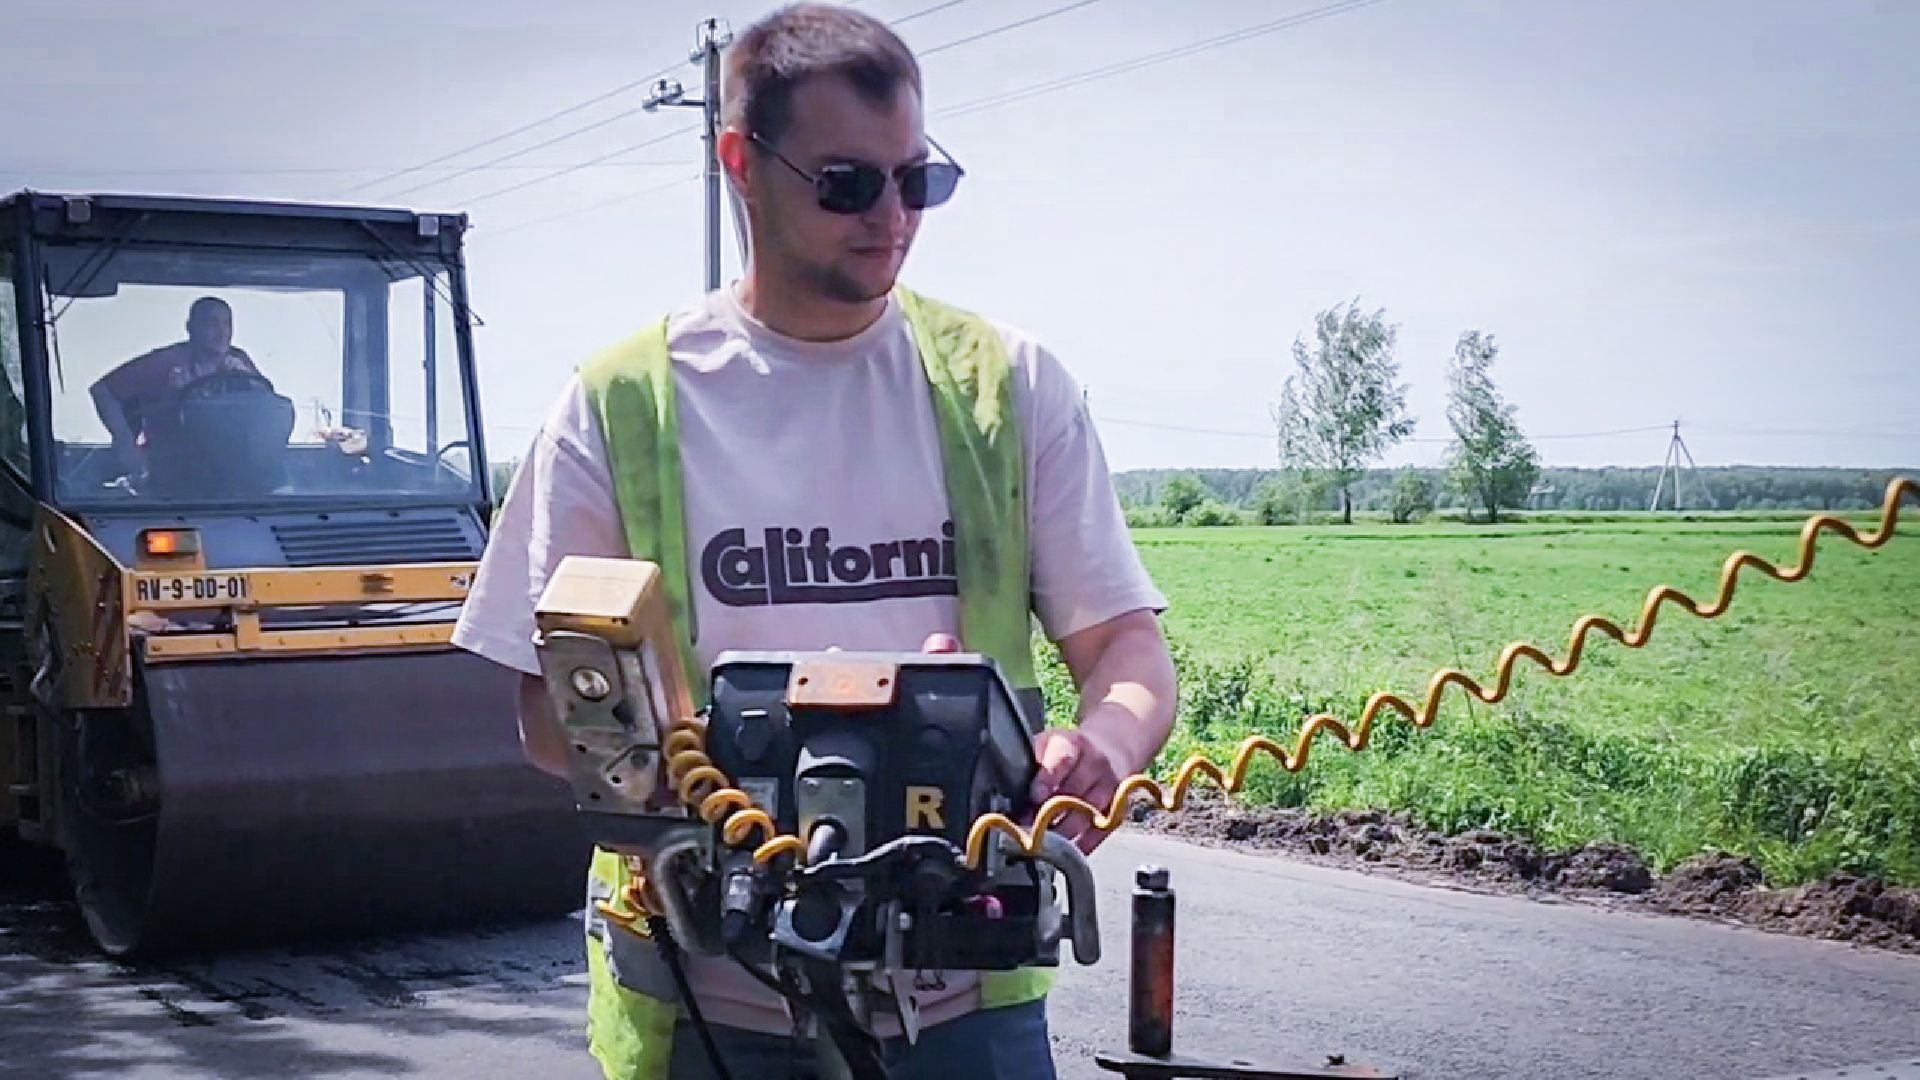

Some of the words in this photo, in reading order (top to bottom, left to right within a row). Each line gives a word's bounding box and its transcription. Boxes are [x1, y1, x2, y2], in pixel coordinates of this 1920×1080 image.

[701, 519, 958, 606] Californi
[136, 576, 247, 601] RV-9-DD-01
[905, 785, 945, 829] R
